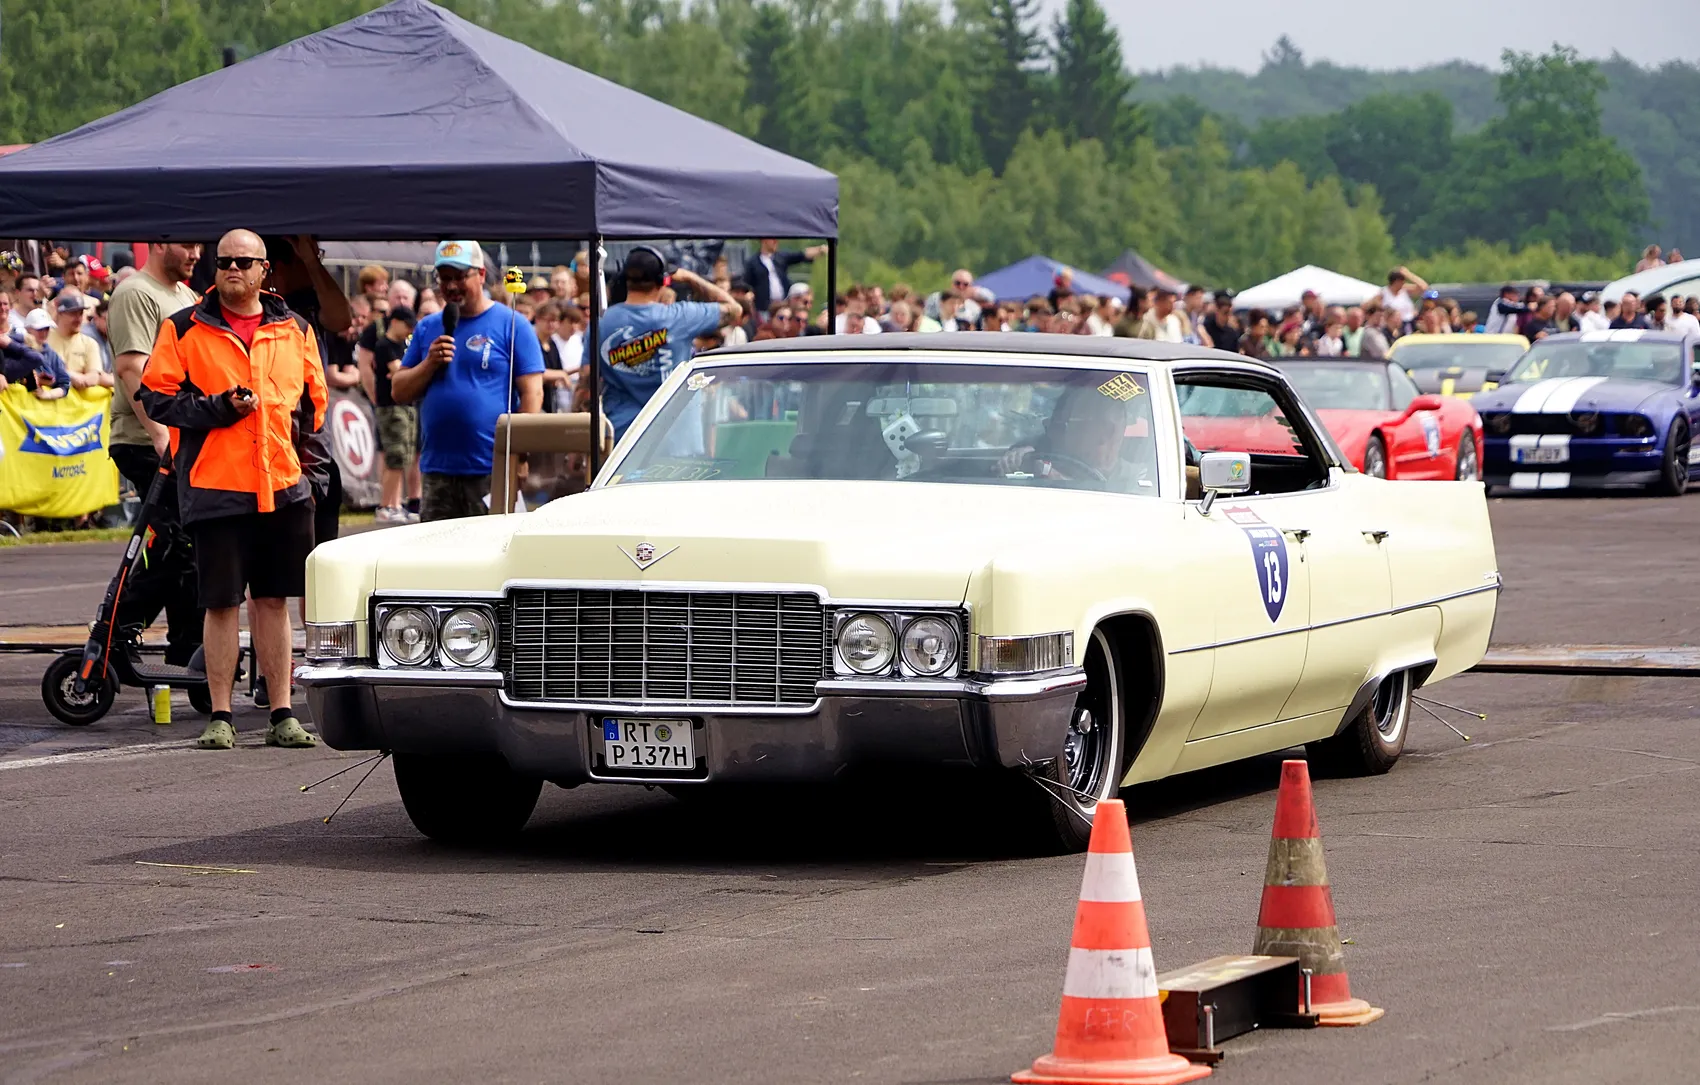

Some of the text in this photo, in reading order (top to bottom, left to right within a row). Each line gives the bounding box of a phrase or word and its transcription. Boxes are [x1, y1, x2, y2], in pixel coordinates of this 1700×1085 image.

[609, 339, 643, 367] DRAG
[643, 328, 669, 351] DAY
[1098, 375, 1127, 395] HETZ
[1263, 550, 1282, 604] 13
[609, 722, 652, 743] D RT
